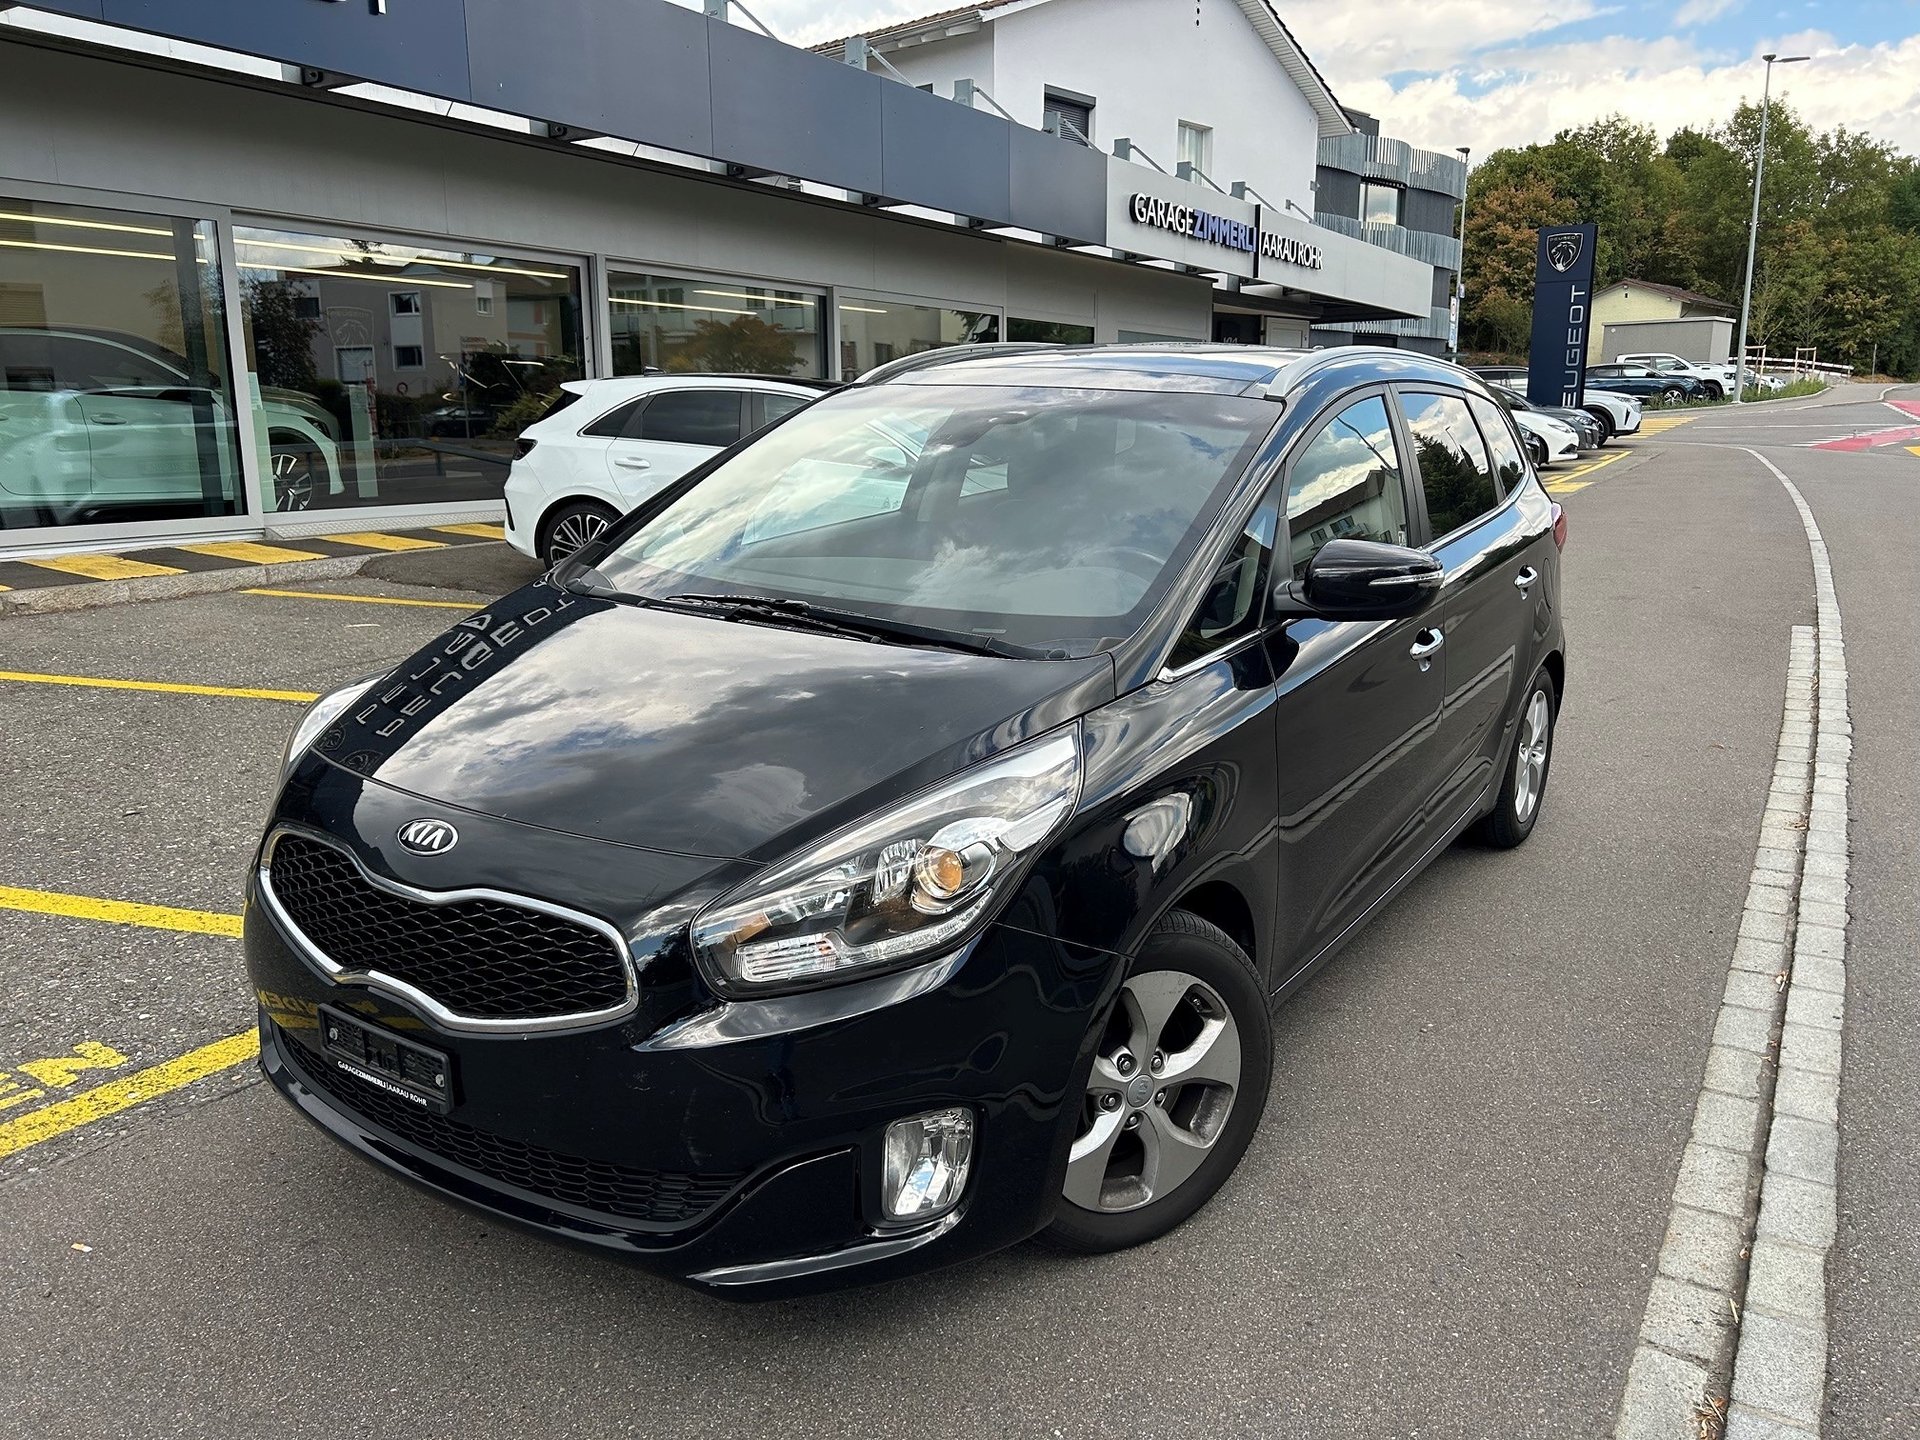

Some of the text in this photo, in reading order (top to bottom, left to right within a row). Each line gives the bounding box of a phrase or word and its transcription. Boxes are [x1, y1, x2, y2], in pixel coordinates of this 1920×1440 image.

[1262, 231, 1299, 264] AARAU
[1298, 241, 1324, 270] ROHR
[401, 822, 446, 850] KIA
[409, 1092, 428, 1106] ROHR
